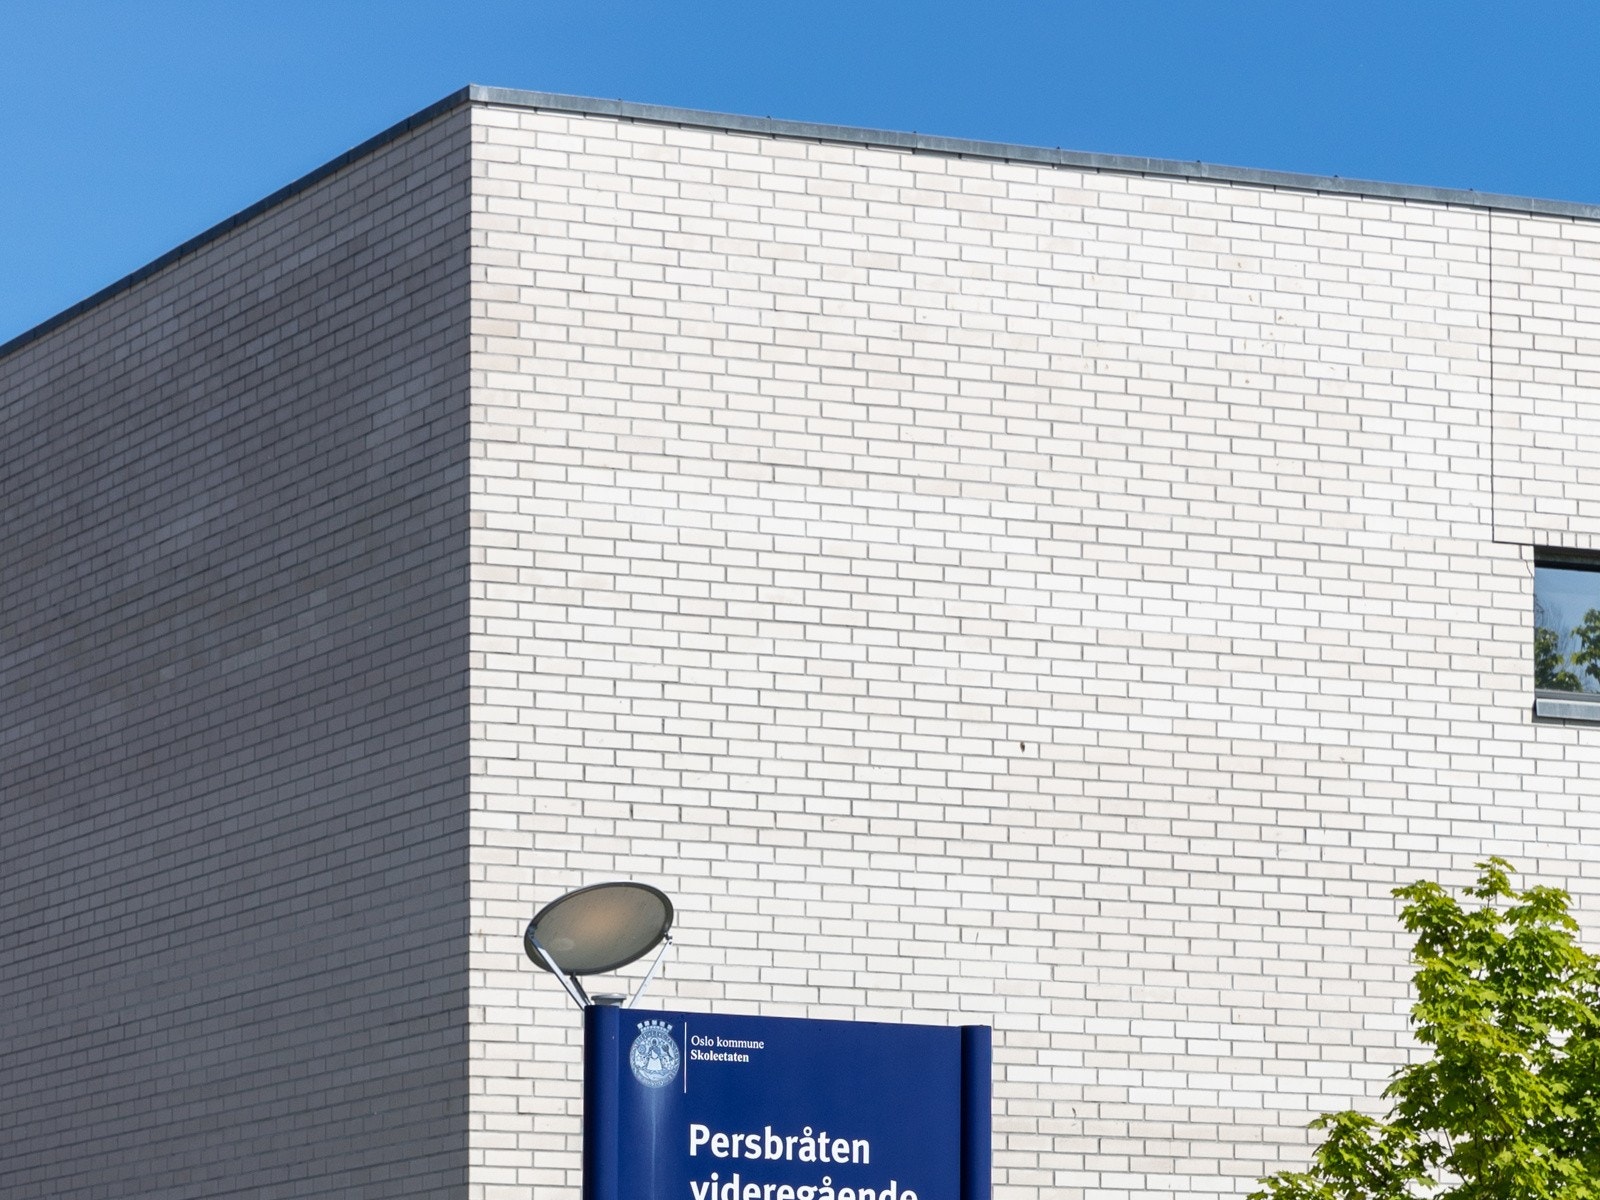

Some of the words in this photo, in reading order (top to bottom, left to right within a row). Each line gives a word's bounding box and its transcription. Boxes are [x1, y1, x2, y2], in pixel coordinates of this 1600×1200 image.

[690, 1035, 715, 1047] Oslo
[716, 1036, 765, 1049] kommune
[690, 1049, 750, 1063] Skoleetaten
[689, 1123, 870, 1164] Persbråten
